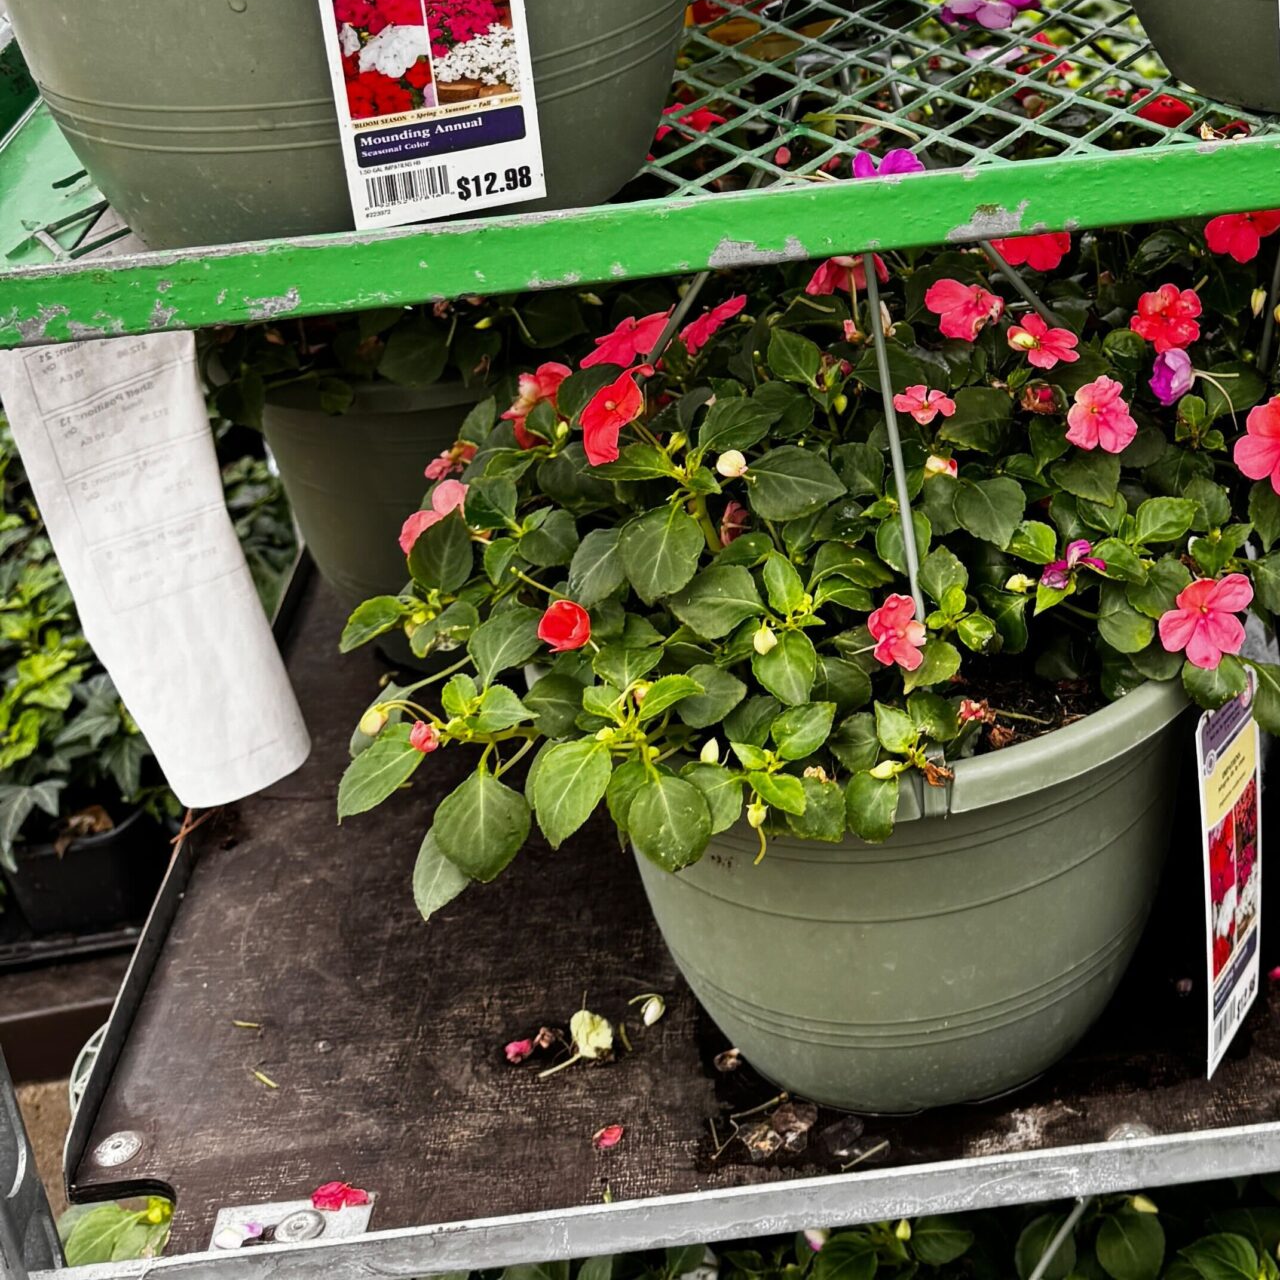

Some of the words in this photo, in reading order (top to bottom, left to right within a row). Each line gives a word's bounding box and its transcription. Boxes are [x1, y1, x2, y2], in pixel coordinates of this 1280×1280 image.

[354, 121, 380, 129] BLOOM
[381, 115, 407, 124] SEASON
[416, 110, 437, 119] Spring
[444, 106, 471, 114] Summer
[360, 127, 431, 147] Mounding
[434, 118, 483, 134] Annual
[361, 145, 402, 158] Seasonal
[404, 140, 430, 150] Color
[457, 165, 532, 201] $12.98
